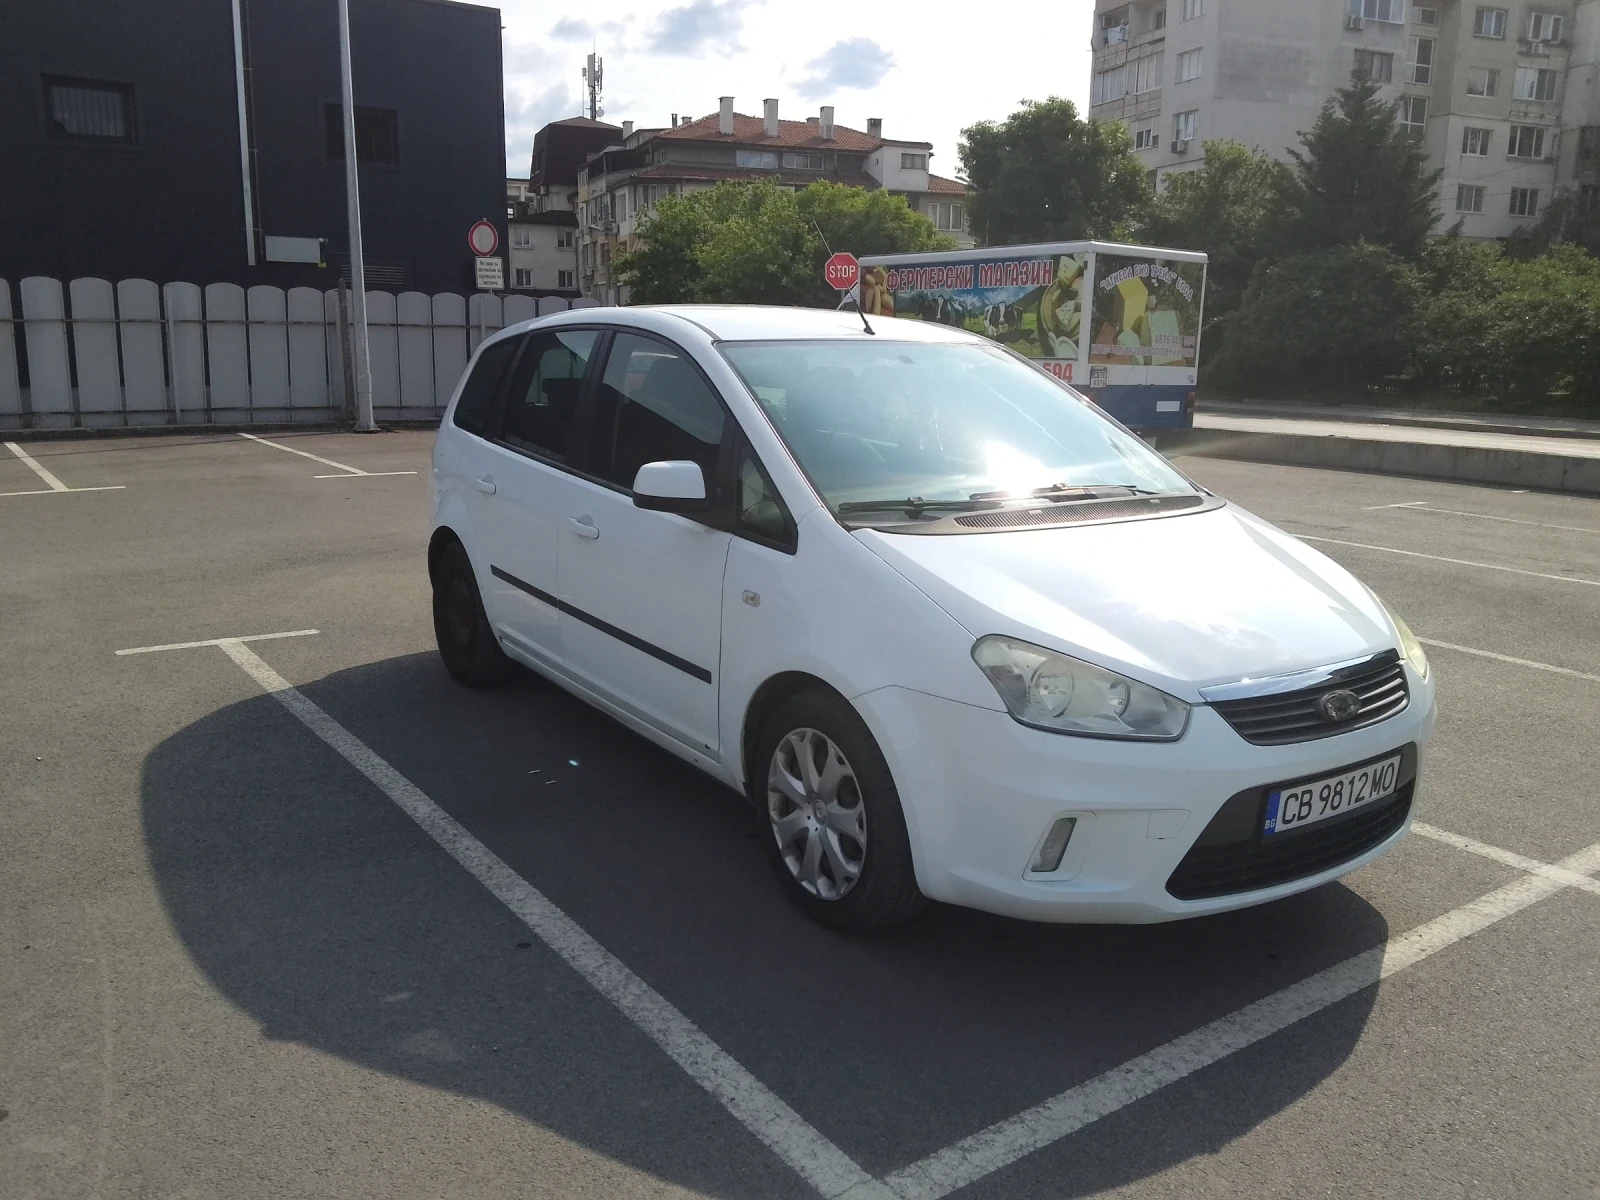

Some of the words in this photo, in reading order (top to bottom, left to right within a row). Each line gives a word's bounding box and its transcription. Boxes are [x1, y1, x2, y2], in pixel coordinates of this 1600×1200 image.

[829, 265, 856, 279] STOP
[886, 264, 974, 292] ФЕРМЕРСКИ
[979, 259, 1053, 289] МАГАЗИН
[1281, 790, 1314, 825] CB
[1319, 772, 1369, 816] 9812
[1369, 762, 1395, 799] MO
[1264, 819, 1276, 830] BG
